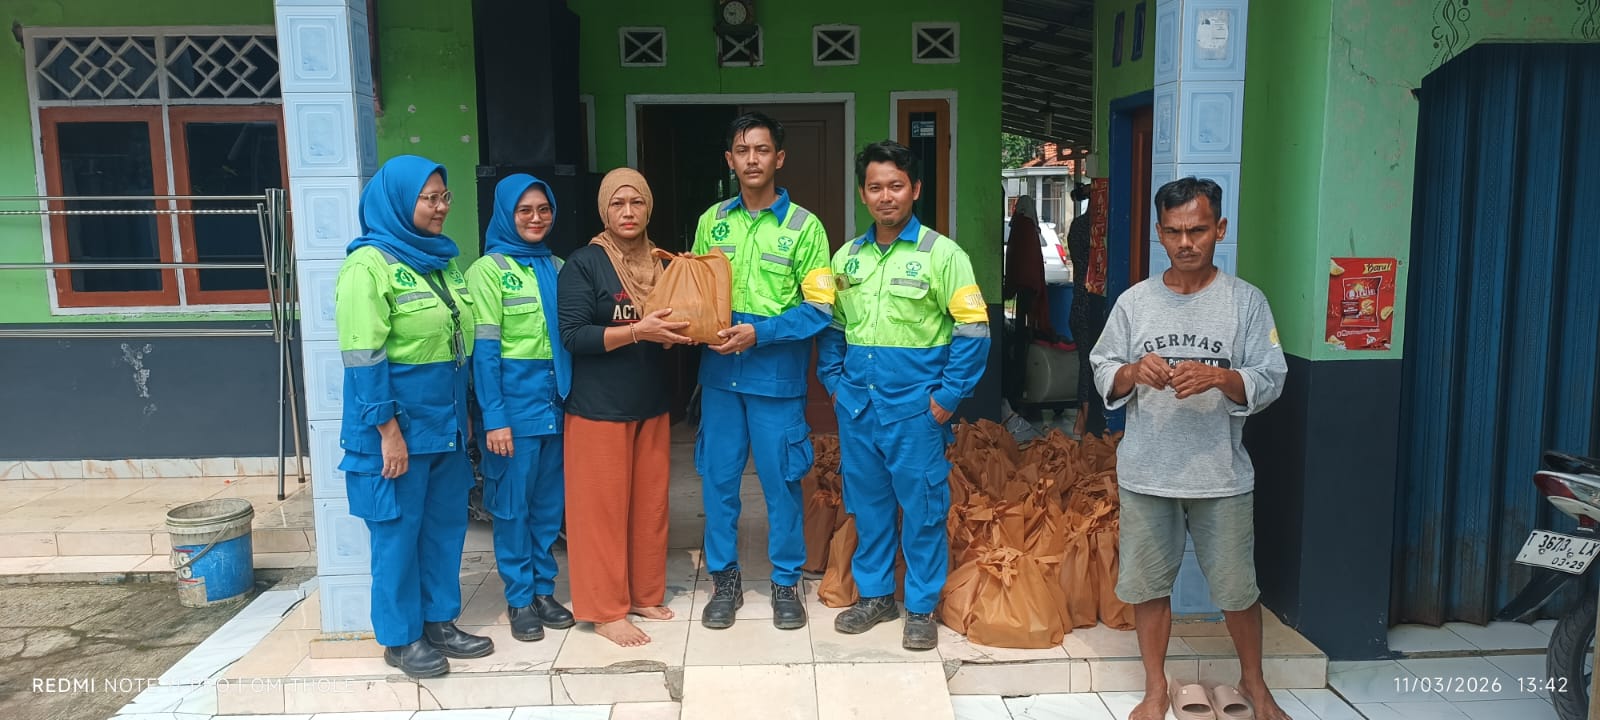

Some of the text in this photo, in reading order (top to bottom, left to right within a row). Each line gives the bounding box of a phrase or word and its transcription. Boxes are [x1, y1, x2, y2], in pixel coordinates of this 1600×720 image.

[1143, 333, 1223, 353] GERMAS
[1527, 532, 1600, 557] T 3673 LX
